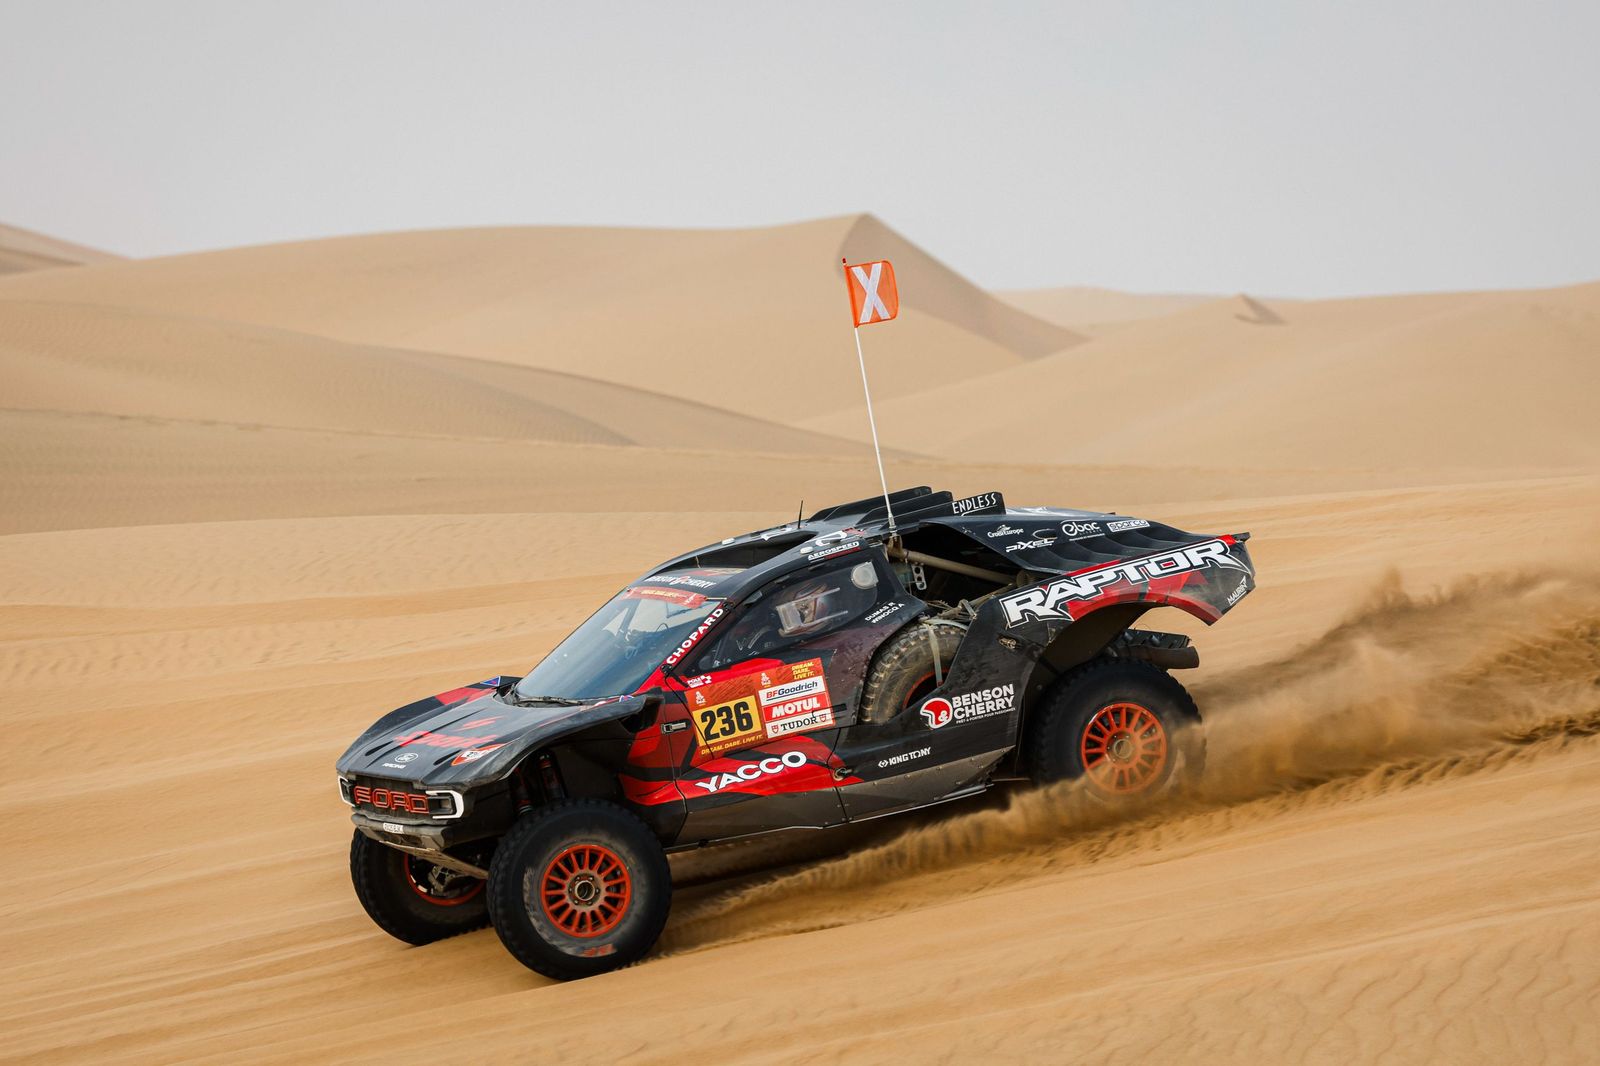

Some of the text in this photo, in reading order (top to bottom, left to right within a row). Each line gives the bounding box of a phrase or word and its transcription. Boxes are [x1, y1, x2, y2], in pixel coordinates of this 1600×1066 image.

[952, 492, 997, 514] ENDLESS
[1108, 520, 1149, 532] sparco
[808, 541, 860, 560] AEROSPEED
[1001, 540, 1248, 626] RAPTOR
[666, 608, 724, 664] CHOPARD
[766, 680, 818, 699] BFGoodrich
[952, 684, 1014, 708] BENSON
[772, 697, 820, 718] MOTUL
[953, 695, 1015, 719] CHERRY
[701, 701, 753, 742] 236
[781, 716, 818, 731] TUDOR
[889, 746, 931, 766] KING TONY
[695, 751, 807, 793] YACCO
[354, 785, 430, 814] FORD
